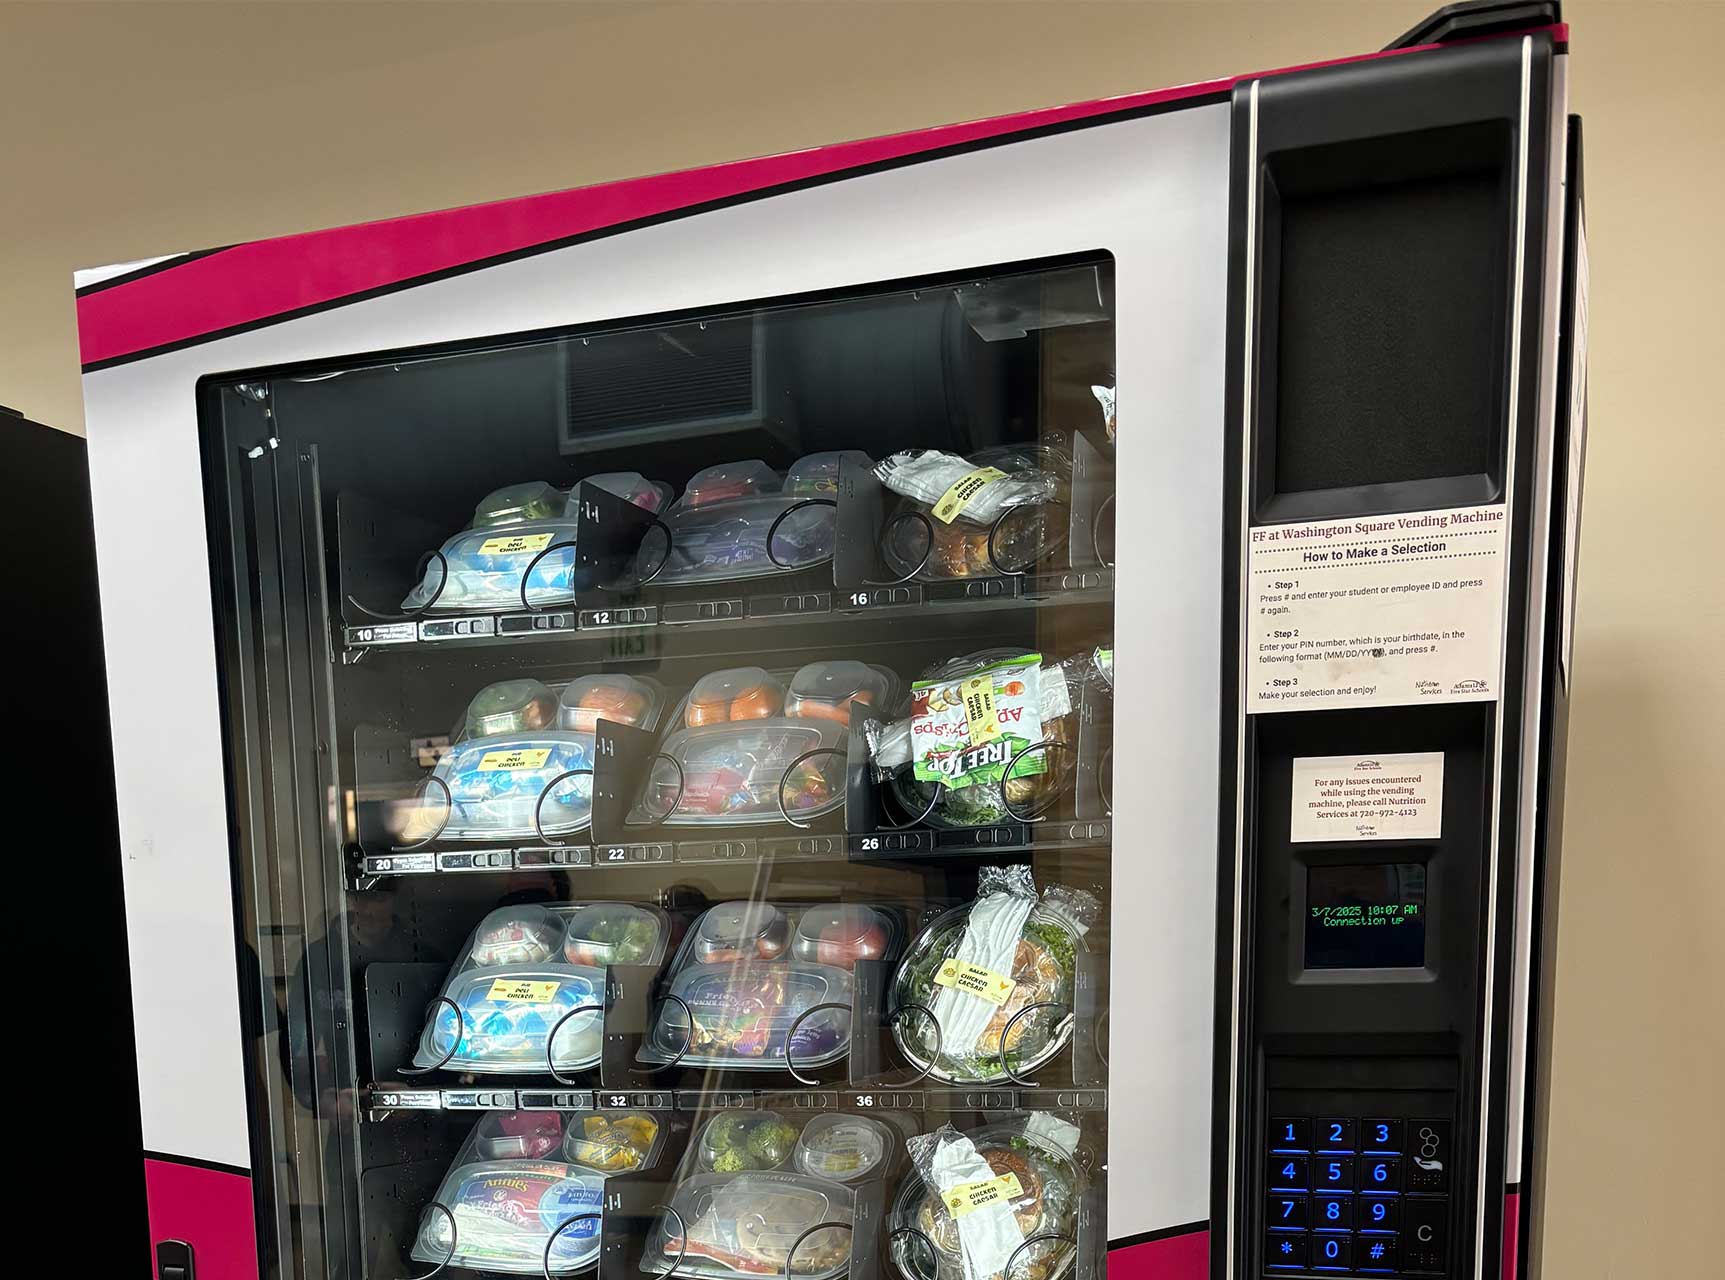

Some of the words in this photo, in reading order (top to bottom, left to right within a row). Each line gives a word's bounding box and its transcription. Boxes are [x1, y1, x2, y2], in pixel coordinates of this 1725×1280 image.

[1252, 531, 1267, 543] FF
[1268, 531, 1280, 541] at
[1282, 525, 1352, 540] Washington
[1354, 521, 1395, 536] Square
[1398, 515, 1448, 530] Vending
[1450, 510, 1503, 525] Machine
[1303, 551, 1329, 563] How
[1331, 550, 1343, 561] to
[1346, 545, 1378, 560] Make
[1381, 548, 1388, 556] a
[1391, 541, 1446, 556] Selection
[1274, 580, 1293, 590] Step
[1295, 580, 1299, 588] 1
[1308, 591, 1328, 599] enter
[1329, 590, 1347, 599] your
[1349, 587, 1379, 596] student
[1391, 582, 1430, 594] employee
[1432, 581, 1441, 590] ID
[1443, 580, 1458, 588] and
[1460, 579, 1483, 589] press
[850, 593, 868, 605] 16
[1267, 606, 1291, 615] again.
[592, 613, 609, 624] 12
[357, 629, 372, 641] 10
[1274, 630, 1292, 640] Step
[1294, 629, 1299, 637] 2
[1259, 642, 1279, 651] Enter
[1280, 642, 1299, 652] your
[1300, 639, 1314, 648] PIN
[1315, 638, 1348, 648] number,
[1349, 635, 1372, 645] which
[1374, 635, 1381, 643] is
[1383, 634, 1401, 644] your
[1403, 632, 1441, 642] birthdate,
[1442, 631, 1450, 639] in
[1451, 630, 1465, 639] the
[1259, 653, 1294, 664] following
[1296, 651, 1322, 661] format
[1389, 646, 1404, 655] and
[1406, 645, 1429, 655] press
[1273, 679, 1291, 688] Step
[1292, 678, 1298, 686] 3
[1258, 691, 1279, 700] Make
[1280, 690, 1298, 700] your
[1300, 687, 1335, 698] selection
[1337, 687, 1351, 695] and
[1353, 685, 1377, 696] enjoy!
[968, 740, 1014, 769] TREE
[927, 748, 968, 779] TOP
[1330, 779, 1343, 787] any
[1372, 775, 1421, 784] encountered
[1321, 789, 1342, 797] while
[1344, 789, 1366, 797] using
[1368, 787, 1380, 795] the
[1382, 787, 1414, 795] vending
[1309, 800, 1344, 808] machine,
[1346, 799, 1371, 808] please
[1389, 797, 1426, 805] Nutrition
[1360, 809, 1417, 818] 720-972-4123
[861, 838, 879, 850] 26
[608, 848, 624, 860] 22
[376, 859, 391, 870] 20
[1312, 906, 1361, 916] 3/7/2025
[1368, 906, 1399, 915] 10:07
[1404, 905, 1417, 914] AM
[1324, 916, 1386, 926] Connection
[958, 979, 983, 992] CAESAR
[961, 973, 988, 987] CHICKEN
[383, 1094, 397, 1105] 30
[610, 1096, 626, 1106] 32
[856, 1096, 873, 1107] 36
[1285, 1124, 1296, 1141] 1
[1330, 1124, 1342, 1141] 2
[1376, 1124, 1389, 1142] 3
[1282, 1163, 1296, 1179] 4
[1329, 1163, 1341, 1180] 5
[1374, 1164, 1387, 1181] 6
[969, 1187, 996, 1199] CHICKEN
[973, 1193, 998, 1205] CAESAR
[1282, 1202, 1294, 1218] 7
[1327, 1203, 1339, 1219] 8
[1373, 1204, 1385, 1220] 9
[1417, 1225, 1432, 1242] C
[1326, 1241, 1338, 1258] 0
[1370, 1243, 1384, 1259] #
